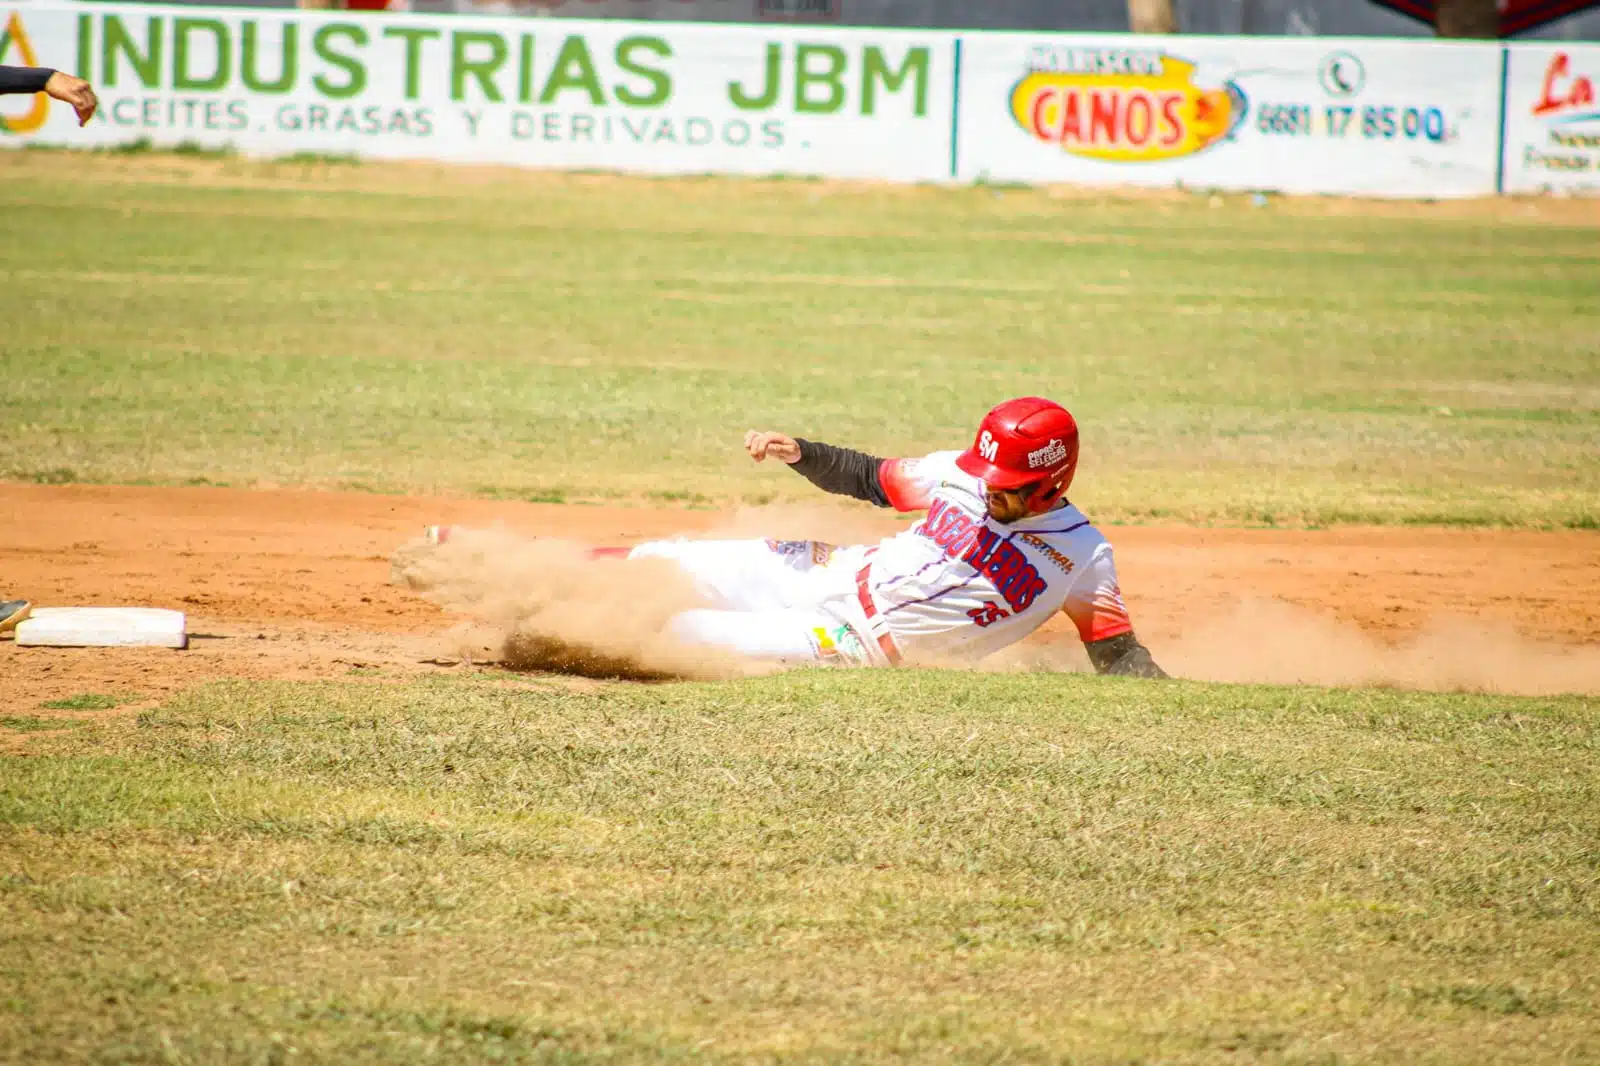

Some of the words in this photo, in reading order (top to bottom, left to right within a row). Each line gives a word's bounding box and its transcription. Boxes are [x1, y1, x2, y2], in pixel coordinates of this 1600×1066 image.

[76, 13, 674, 107] INDUSTRIAS
[728, 41, 930, 117] JBM
[276, 104, 434, 136] GRASAS
[464, 109, 482, 136] Y
[1325, 105, 1353, 137] 17
